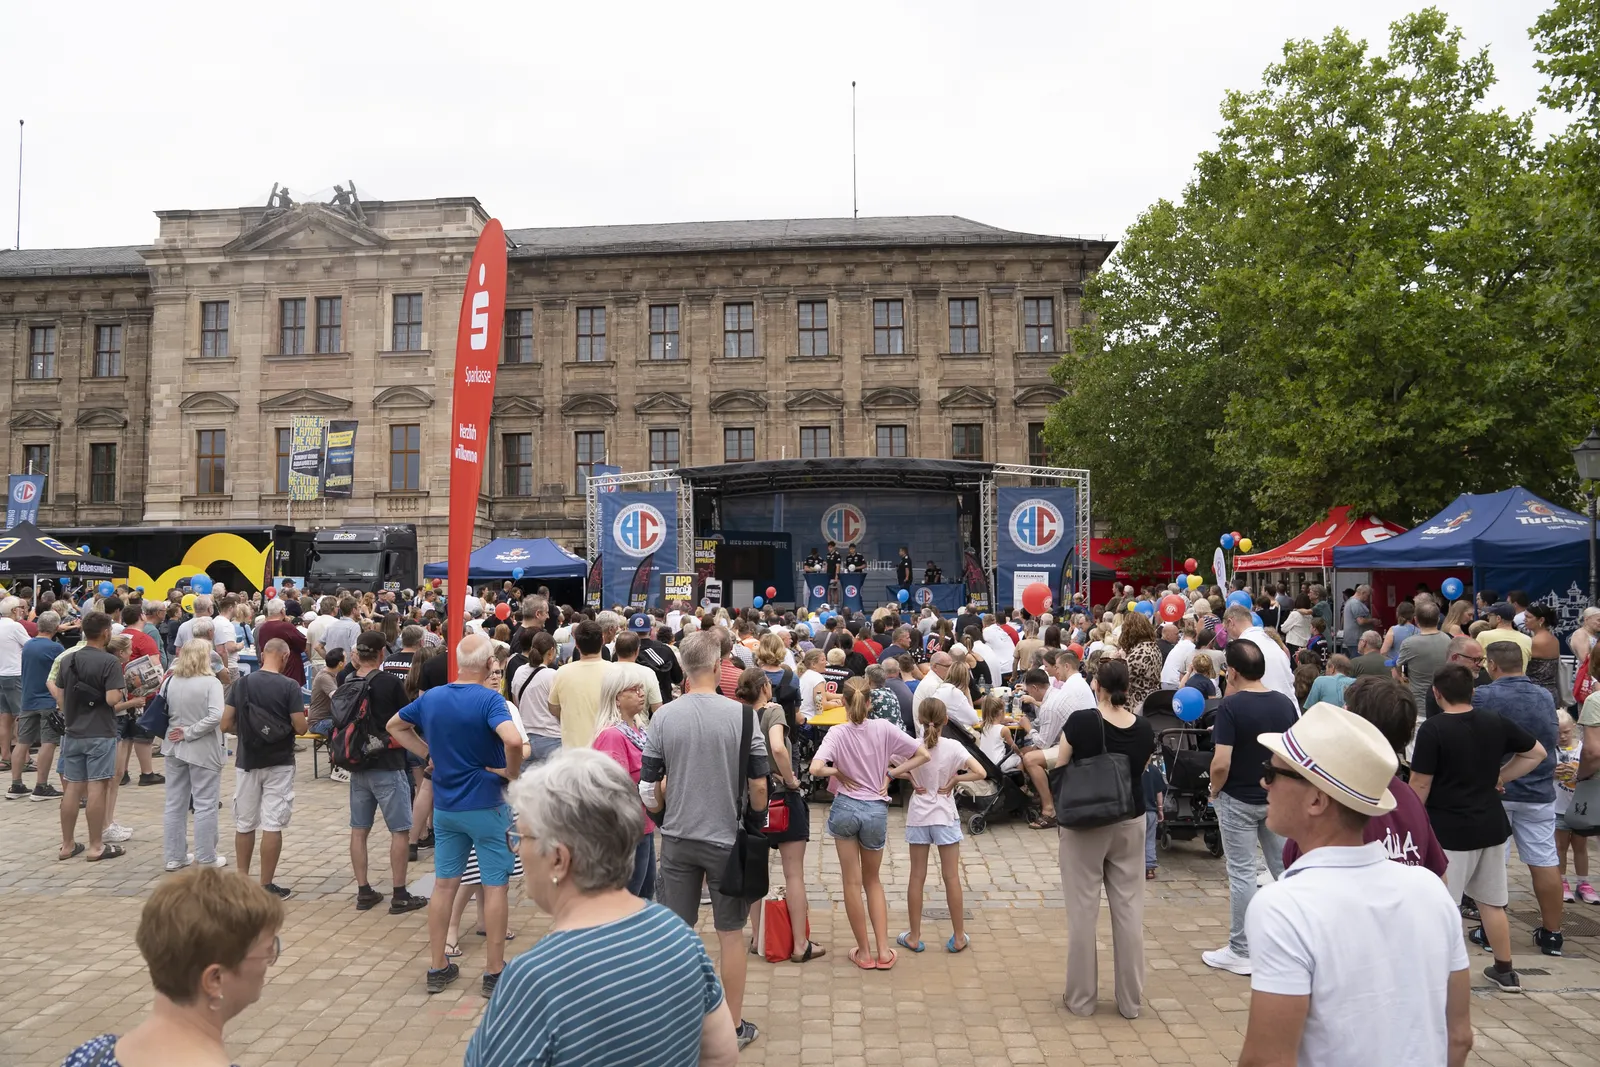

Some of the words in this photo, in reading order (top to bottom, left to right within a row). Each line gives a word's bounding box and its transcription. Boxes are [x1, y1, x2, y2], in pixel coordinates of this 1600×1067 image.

[465, 366, 491, 387] Sparkasse
[300, 427, 322, 436] FUTURE
[460, 423, 477, 440] Herzlich
[1016, 506, 1057, 546] HC
[1515, 516, 1589, 526] Tucher
[621, 510, 659, 549] HC
[56, 562, 67, 571] Wir
[675, 576, 692, 587] APP
